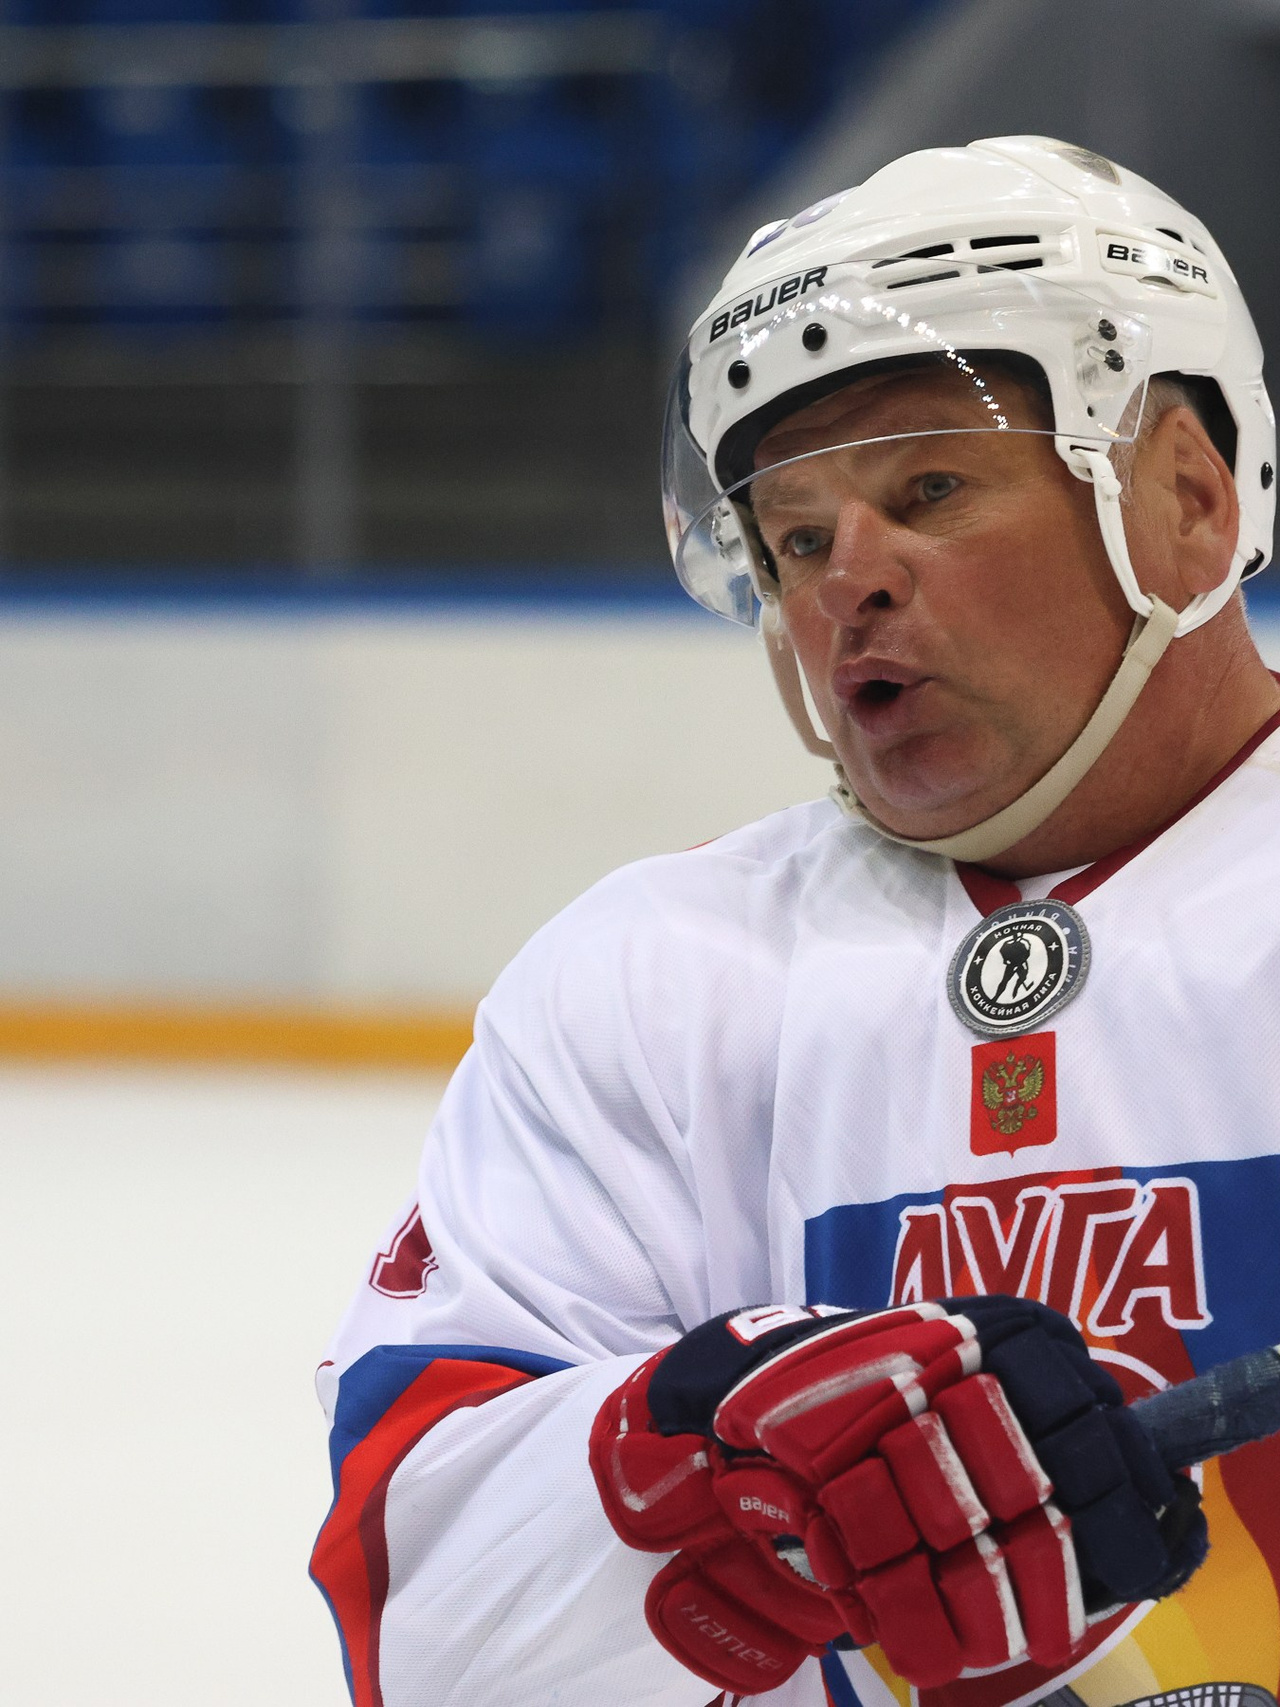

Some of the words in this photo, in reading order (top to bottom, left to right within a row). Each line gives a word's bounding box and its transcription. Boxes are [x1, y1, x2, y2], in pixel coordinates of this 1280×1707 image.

[709, 265, 828, 344] BAUER
[994, 923, 1043, 940] НОЧНАЯ
[970, 985, 1030, 1017] ХОККЕЙНАЯ
[1032, 972, 1057, 1002] ЛИГА
[888, 1175, 1214, 1337] ЛУГА
